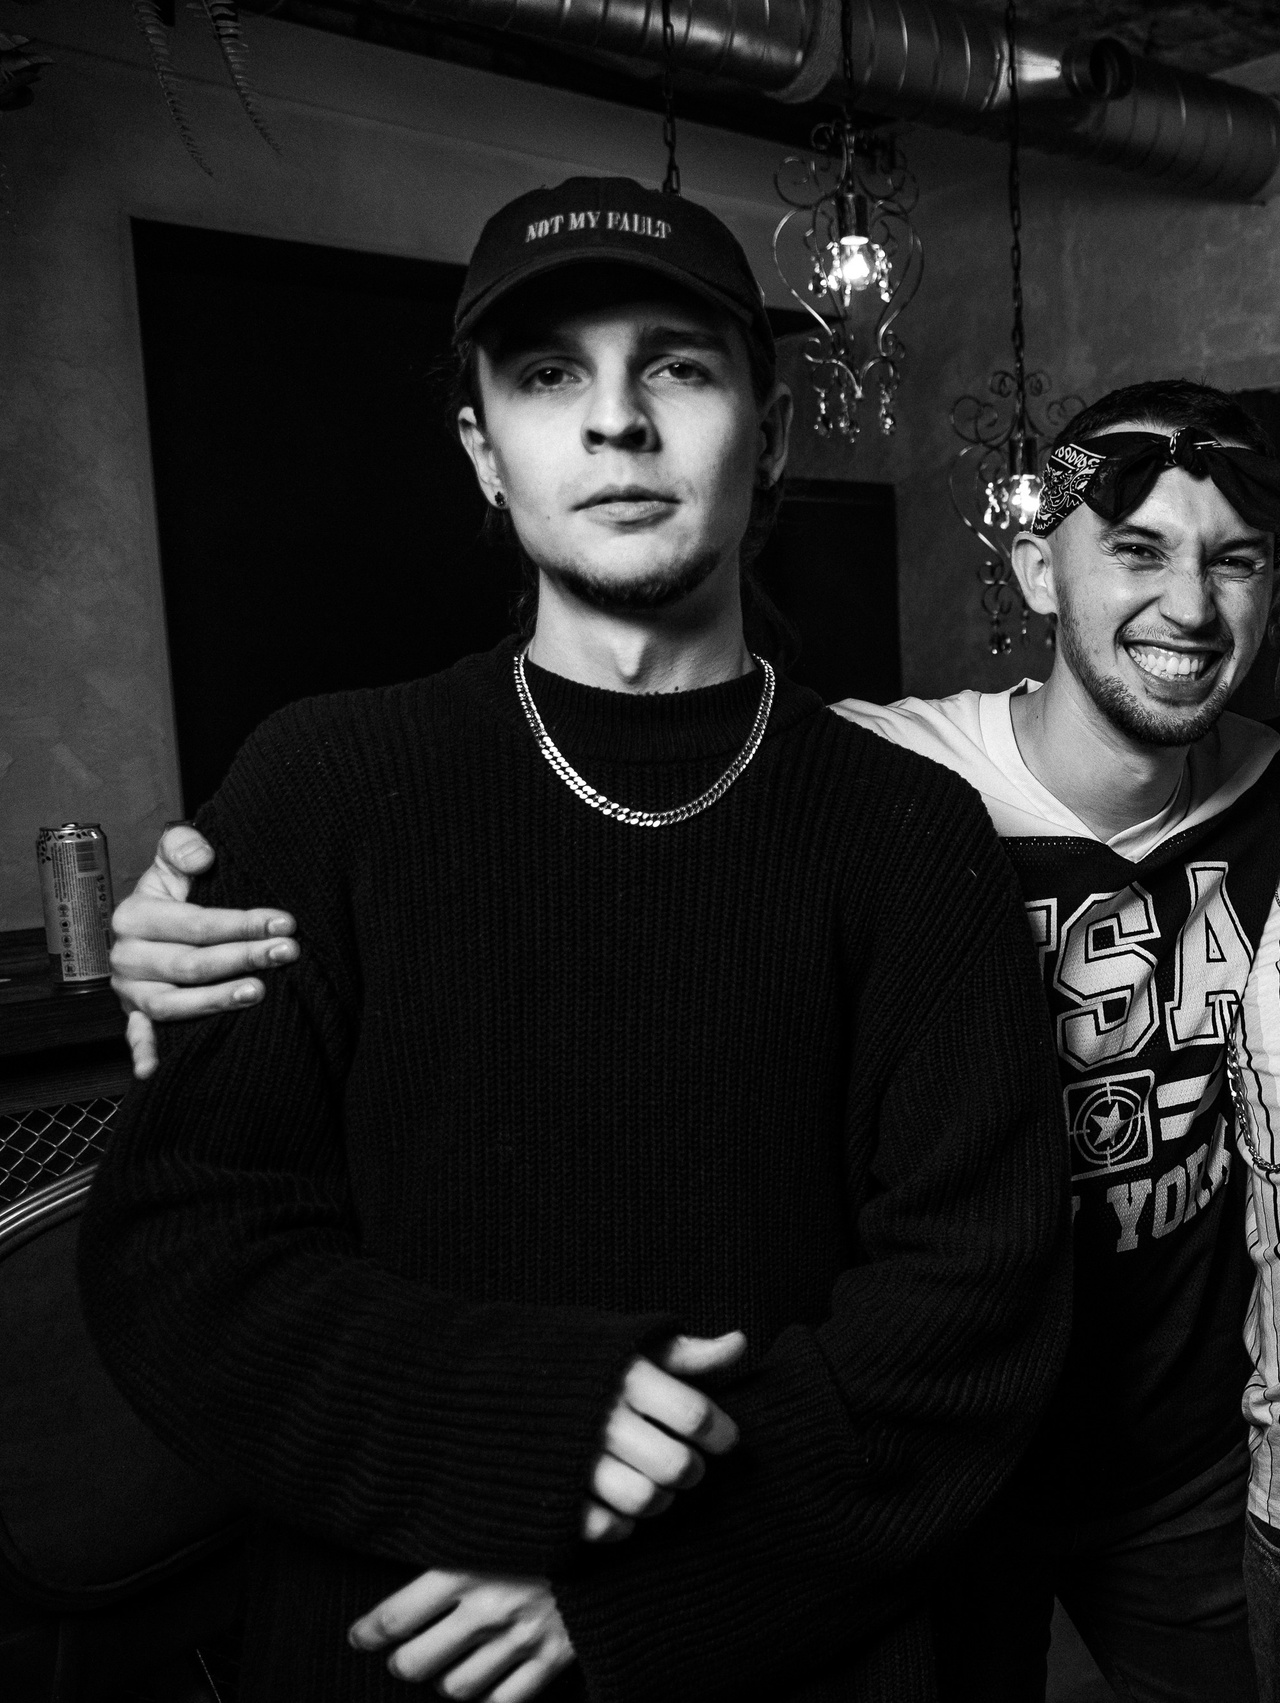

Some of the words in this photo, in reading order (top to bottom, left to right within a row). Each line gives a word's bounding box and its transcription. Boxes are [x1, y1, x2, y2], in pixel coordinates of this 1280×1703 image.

[525, 214, 565, 243] NOT
[568, 211, 601, 231] MY
[606, 211, 672, 239] FAULT
[1025, 861, 1254, 1073] SA
